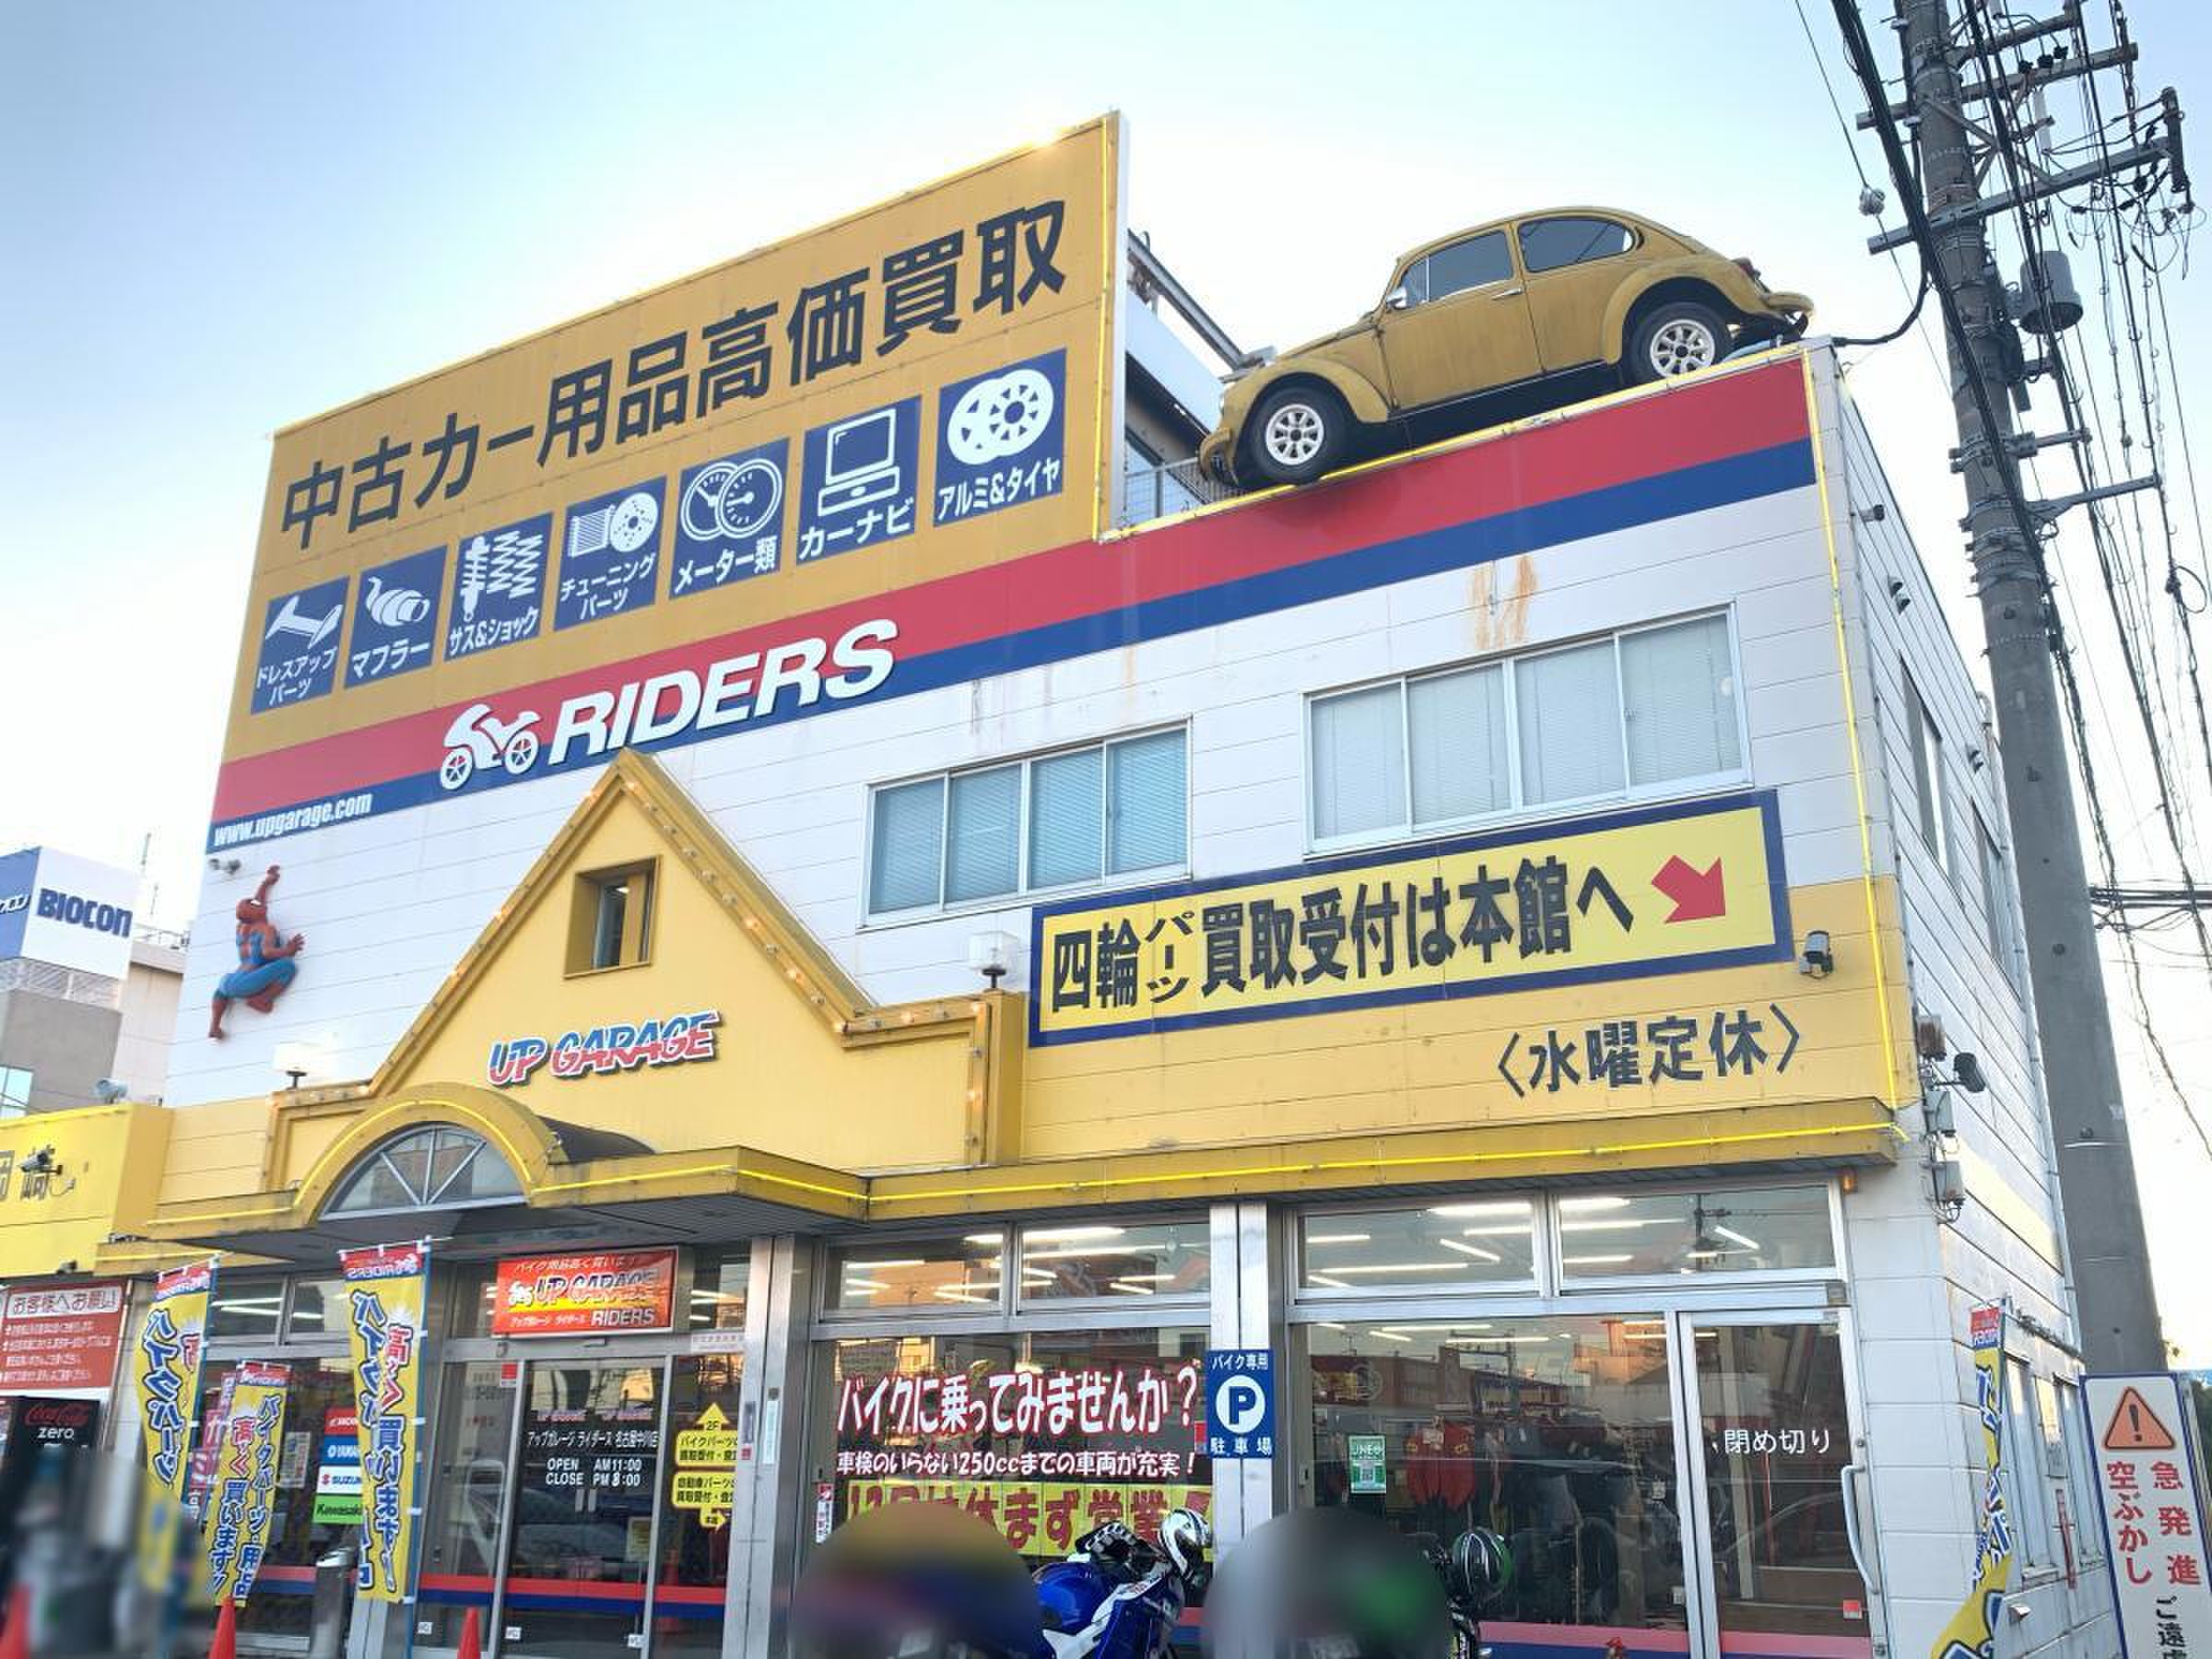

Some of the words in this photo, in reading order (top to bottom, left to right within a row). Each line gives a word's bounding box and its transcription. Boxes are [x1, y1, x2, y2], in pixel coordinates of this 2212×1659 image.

[280, 199, 1067, 550] 中古カー用品高価買取
[938, 457, 1060, 521] アルミ&タイヤ
[799, 496, 914, 560] カーナビ
[560, 553, 655, 601] チューニング
[675, 535, 777, 593] メーター類
[580, 588, 628, 619] パーツ
[450, 606, 538, 655] サス&ショック
[256, 647, 337, 688] ドレスアップ
[353, 639, 429, 678] マフラー
[269, 678, 312, 706] パーツ
[548, 618, 898, 766] RIDERS
[214, 794, 372, 846] www.upgarage.com
[488, 1037, 547, 1086] UP
[550, 1009, 719, 1077] GARAGE
[534, 1275, 567, 1303] UP
[569, 1268, 659, 1303] GARAGE
[591, 1308, 655, 1327] RIDERS
[1229, 1386, 1256, 1425] P
[38, 1427, 75, 1440] zero
[1724, 1430, 1830, 1454] 閉め切り
[546, 1473, 584, 1486] CLOSE
[547, 1458, 579, 1471] OPEN
[2107, 1461, 2152, 1585] 空ぶかし
[2150, 1461, 2201, 1585] 急発進
